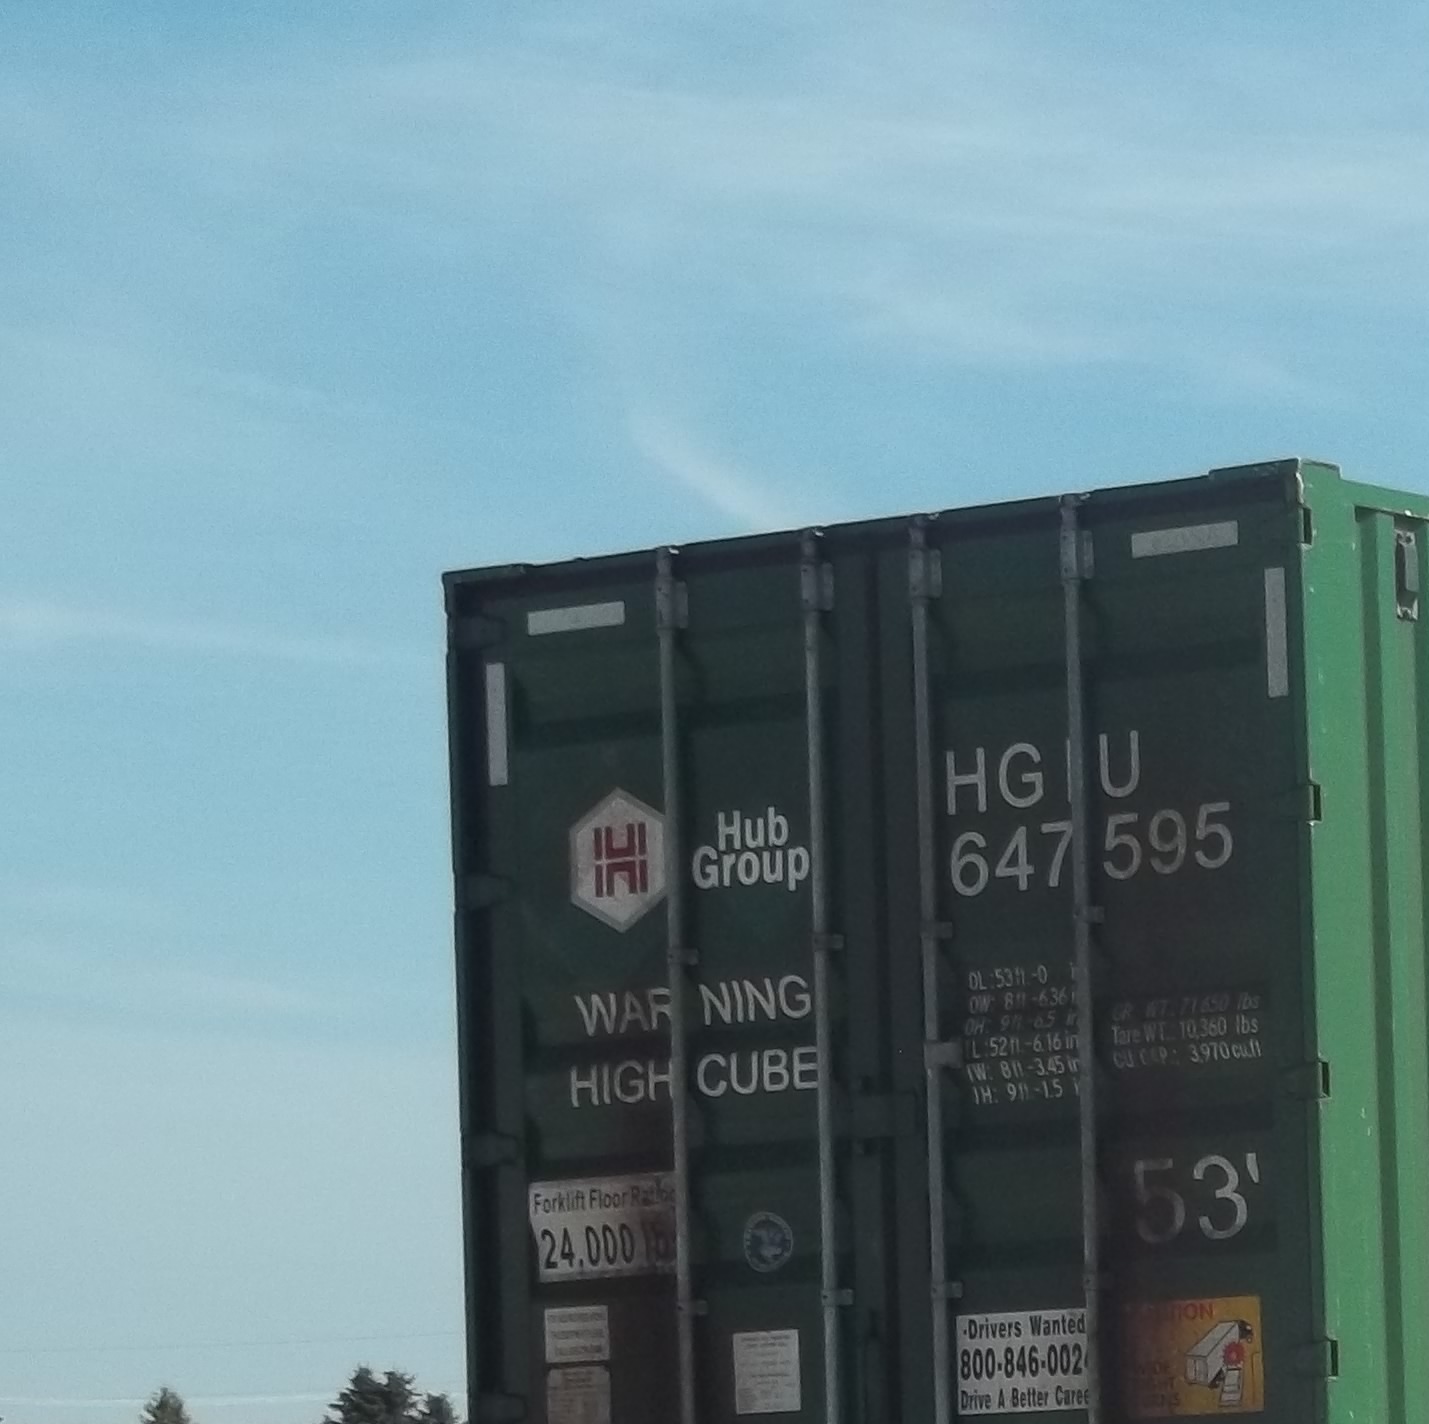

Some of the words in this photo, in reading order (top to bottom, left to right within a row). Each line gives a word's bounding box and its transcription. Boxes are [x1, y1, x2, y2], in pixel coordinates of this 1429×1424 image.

[946, 730, 1141, 816] HGU
[718, 807, 789, 852] Hub
[950, 801, 1234, 897] 647595
[692, 845, 810, 892] Group
[1236, 1013, 1259, 1035] lbs
[569, 1058, 673, 1108] HIGH
[697, 1046, 818, 1098] CUBE
[533, 1189, 586, 1216] Forklift
[590, 1186, 629, 1210] Floor
[1029, 1313, 1086, 1336] Wanted
[961, 1389, 992, 1411] Drive
[998, 1387, 1006, 1409] A
[1012, 1387, 1049, 1408] Better
